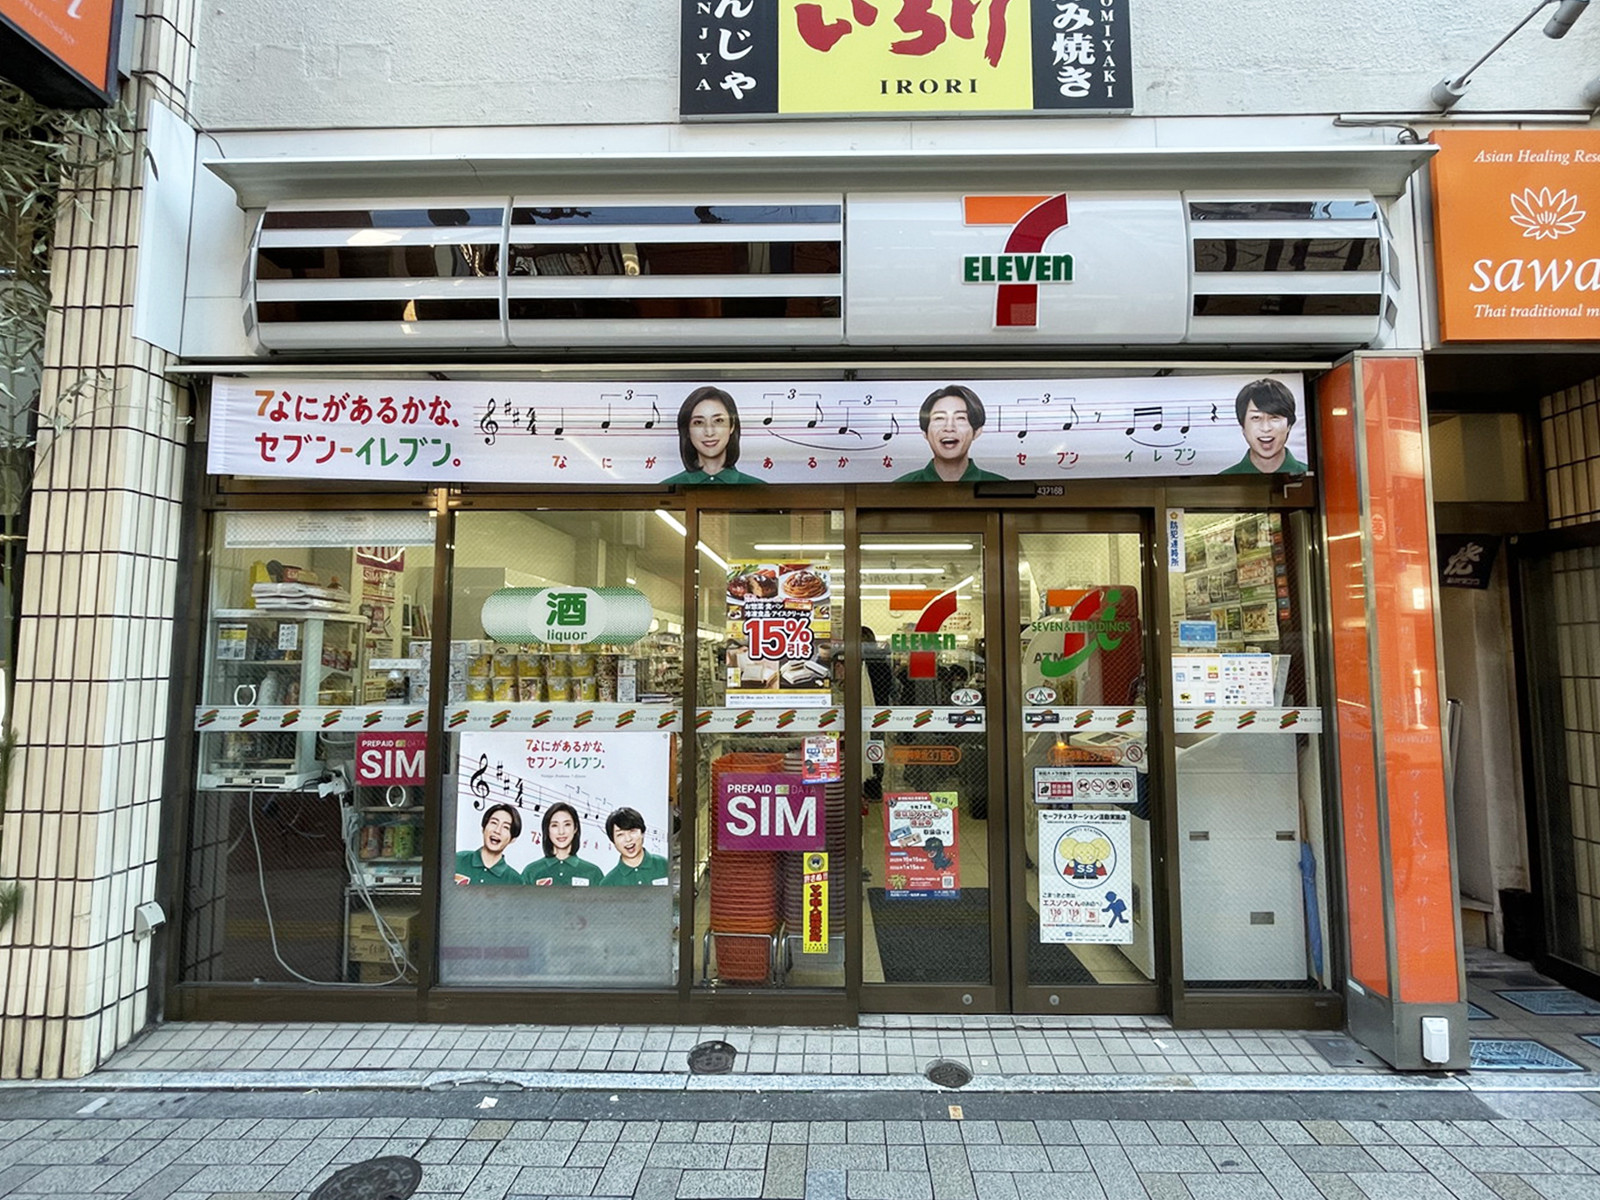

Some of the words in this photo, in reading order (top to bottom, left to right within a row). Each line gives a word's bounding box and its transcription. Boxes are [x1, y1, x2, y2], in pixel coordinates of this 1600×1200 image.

[1052, 0, 1096, 98] み焼き
[880, 79, 978, 95] IRORI
[1474, 150, 1513, 163] Asian
[1517, 150, 1570, 165] Healing
[1474, 304, 1506, 318] Thai
[1510, 303, 1582, 317] traditional
[254, 390, 460, 428] 7なにがあるかな、
[645, 456, 657, 469] が
[763, 457, 773, 469] あ
[808, 457, 818, 469] る
[838, 457, 849, 468] か
[883, 456, 893, 468] な
[1017, 453, 1027, 465] セ
[1057, 452, 1079, 465] ブン
[1174, 448, 1196, 461] ブン
[546, 592, 587, 626] 酒
[1079, 621, 1131, 632] HOLDINGS
[547, 629, 587, 643] liquor
[745, 619, 811, 657] 15%
[787, 643, 813, 658] 引き
[361, 739, 394, 747] PREPAID
[360, 750, 426, 779] SIM
[727, 784, 772, 794] PREPAID
[725, 795, 817, 836] SIM
